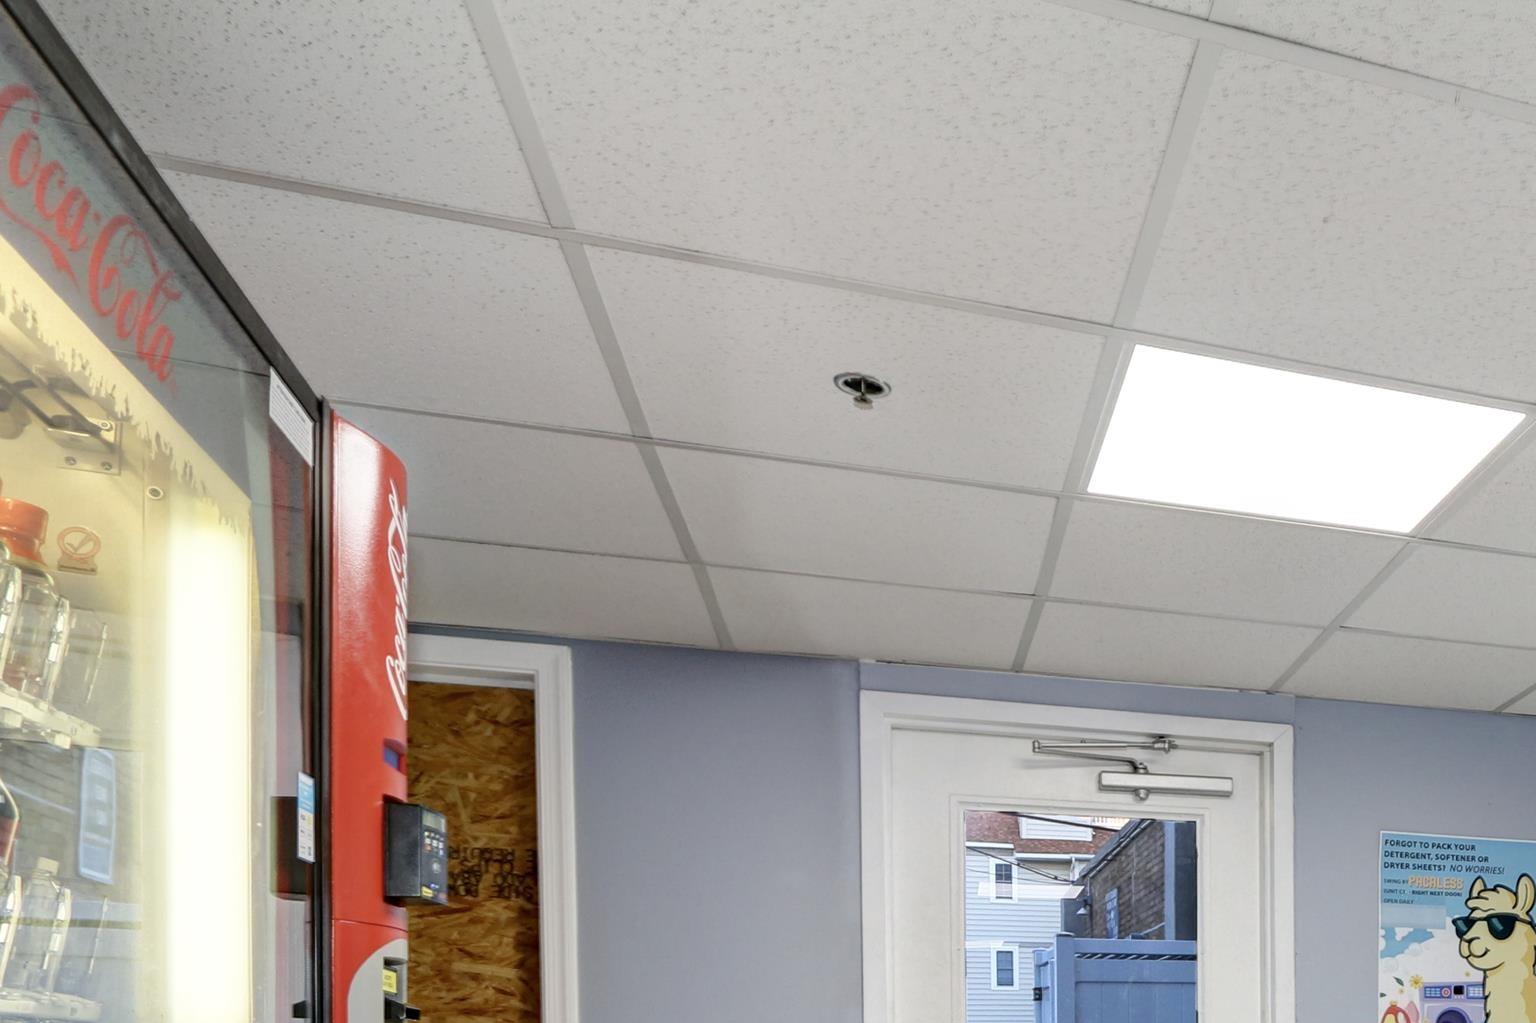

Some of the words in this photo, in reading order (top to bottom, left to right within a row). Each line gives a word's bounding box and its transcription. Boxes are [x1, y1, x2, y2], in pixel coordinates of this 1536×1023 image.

[1384, 839, 1418, 849] FORGOT
[1420, 841, 1430, 849] TO
[1431, 841, 1453, 850] PACK
[1454, 843, 1476, 851] YOUR
[1384, 850, 1433, 861] DETERGENT,
[1435, 853, 1476, 862] SOFTENER
[1478, 855, 1489, 863] OR
[1384, 862, 1410, 870] DRYER
[1412, 863, 1446, 872] SHEETS?
[1450, 864, 1463, 872] NO
[1465, 865, 1505, 875] WORRIES!
